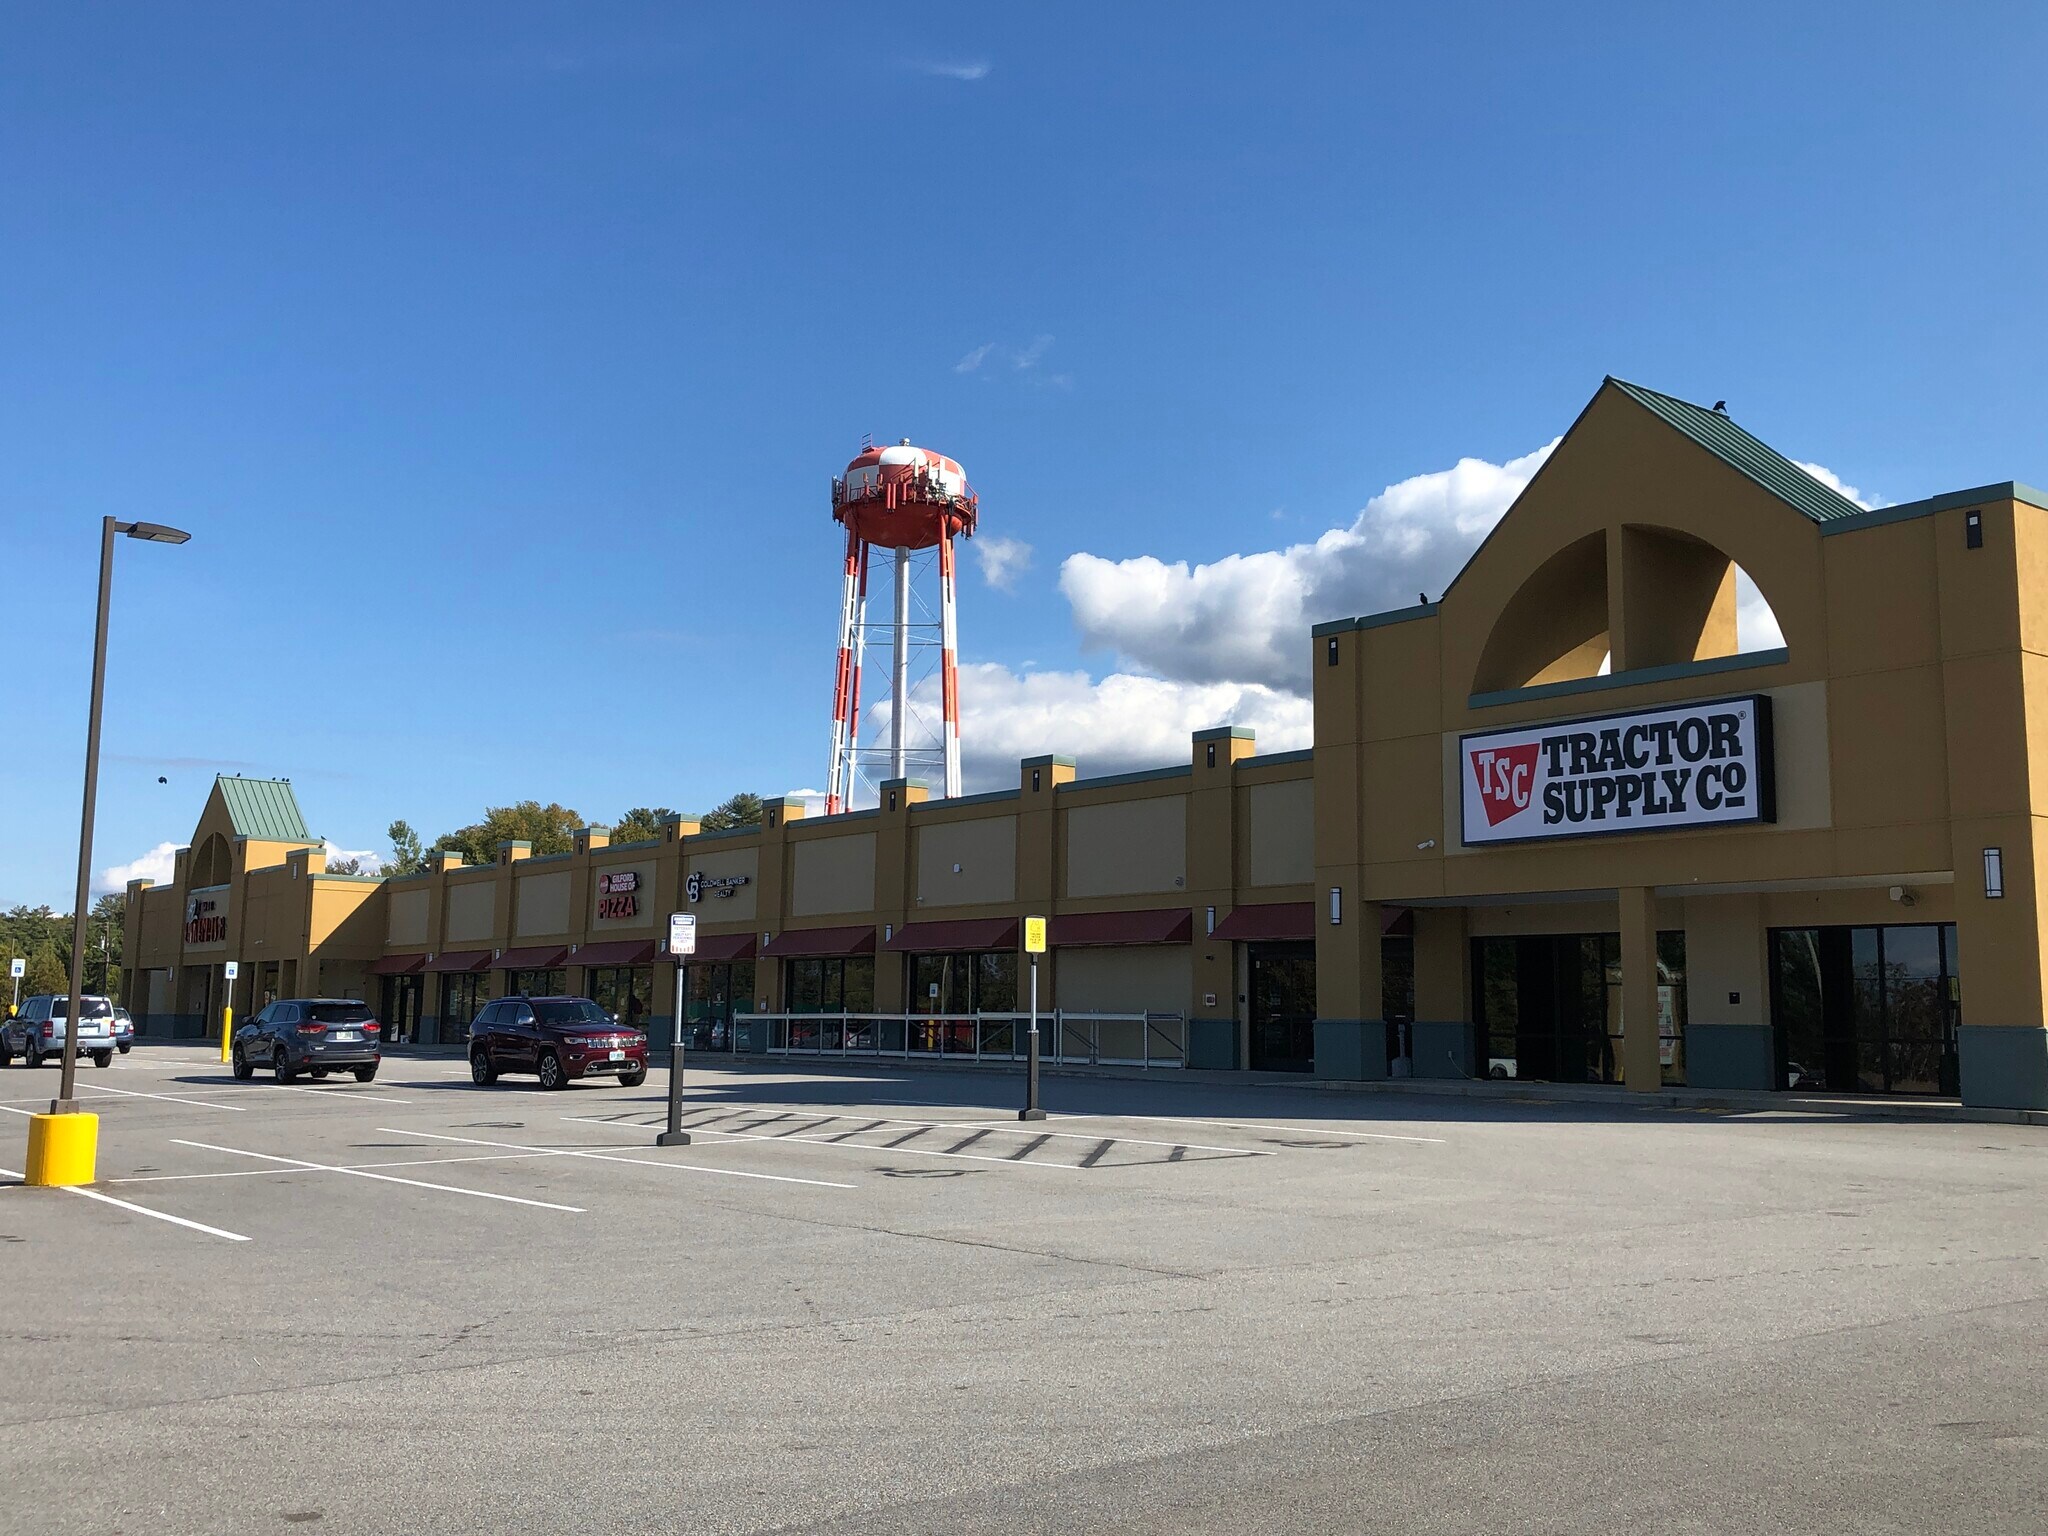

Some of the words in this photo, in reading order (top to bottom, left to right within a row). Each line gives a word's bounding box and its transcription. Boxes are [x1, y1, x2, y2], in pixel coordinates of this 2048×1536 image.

[1542, 714, 1743, 778] TRACTOR
[1478, 751, 1528, 808] TSC
[1543, 767, 1692, 825] SUPPLY
[610, 882, 628, 893] HOUSE
[628, 881, 636, 891] OF
[612, 873, 634, 884] GILFORD
[700, 879, 725, 889] COLDWELL
[726, 876, 746, 886] BANKER
[599, 896, 634, 919] PIZZA
